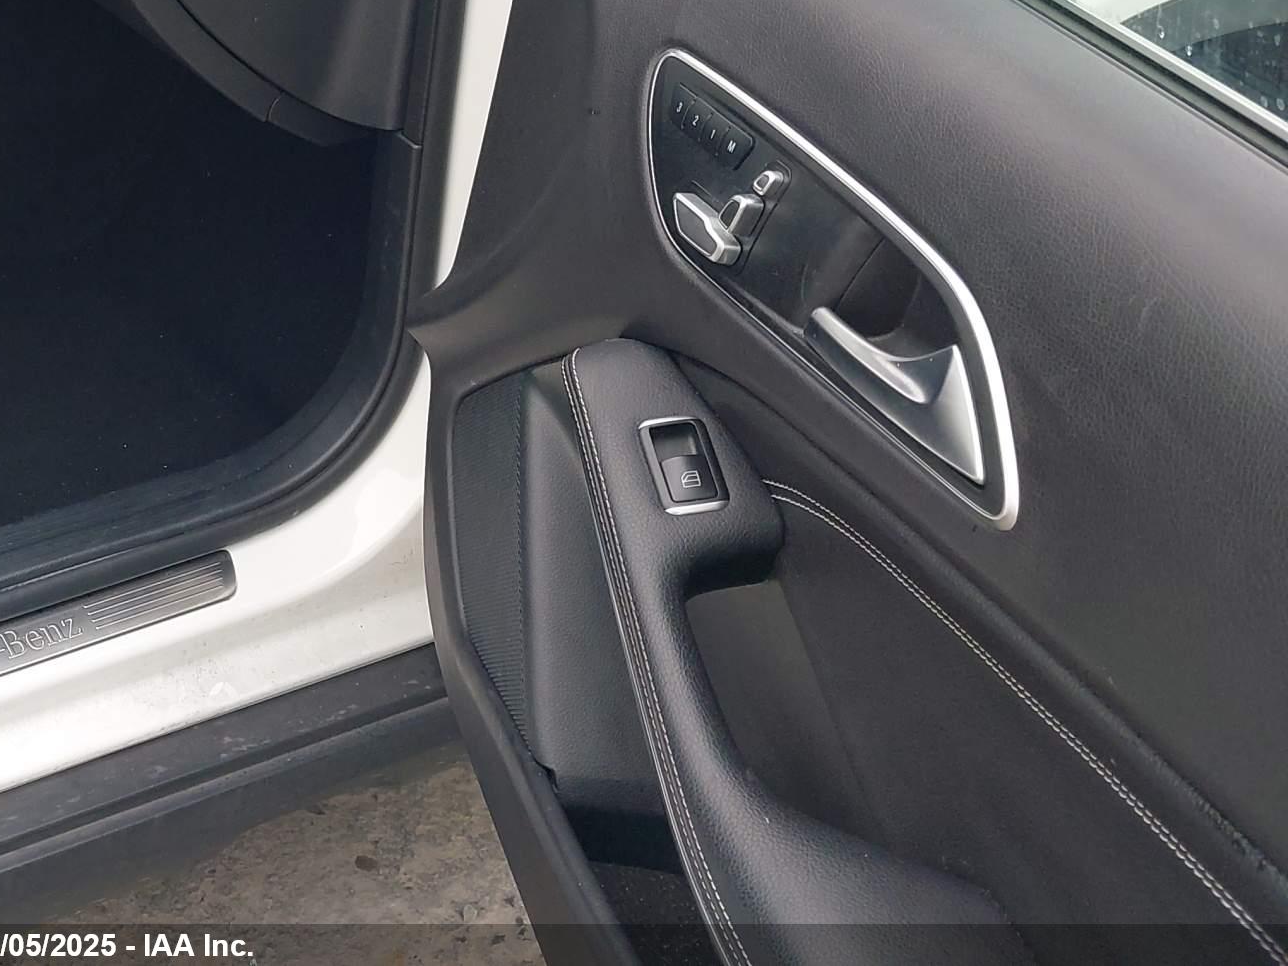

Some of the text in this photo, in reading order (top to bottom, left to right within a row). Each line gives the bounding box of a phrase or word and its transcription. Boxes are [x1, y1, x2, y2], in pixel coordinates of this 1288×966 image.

[676, 101, 683, 113] 3
[692, 115, 699, 126] 2
[727, 140, 736, 153] M
